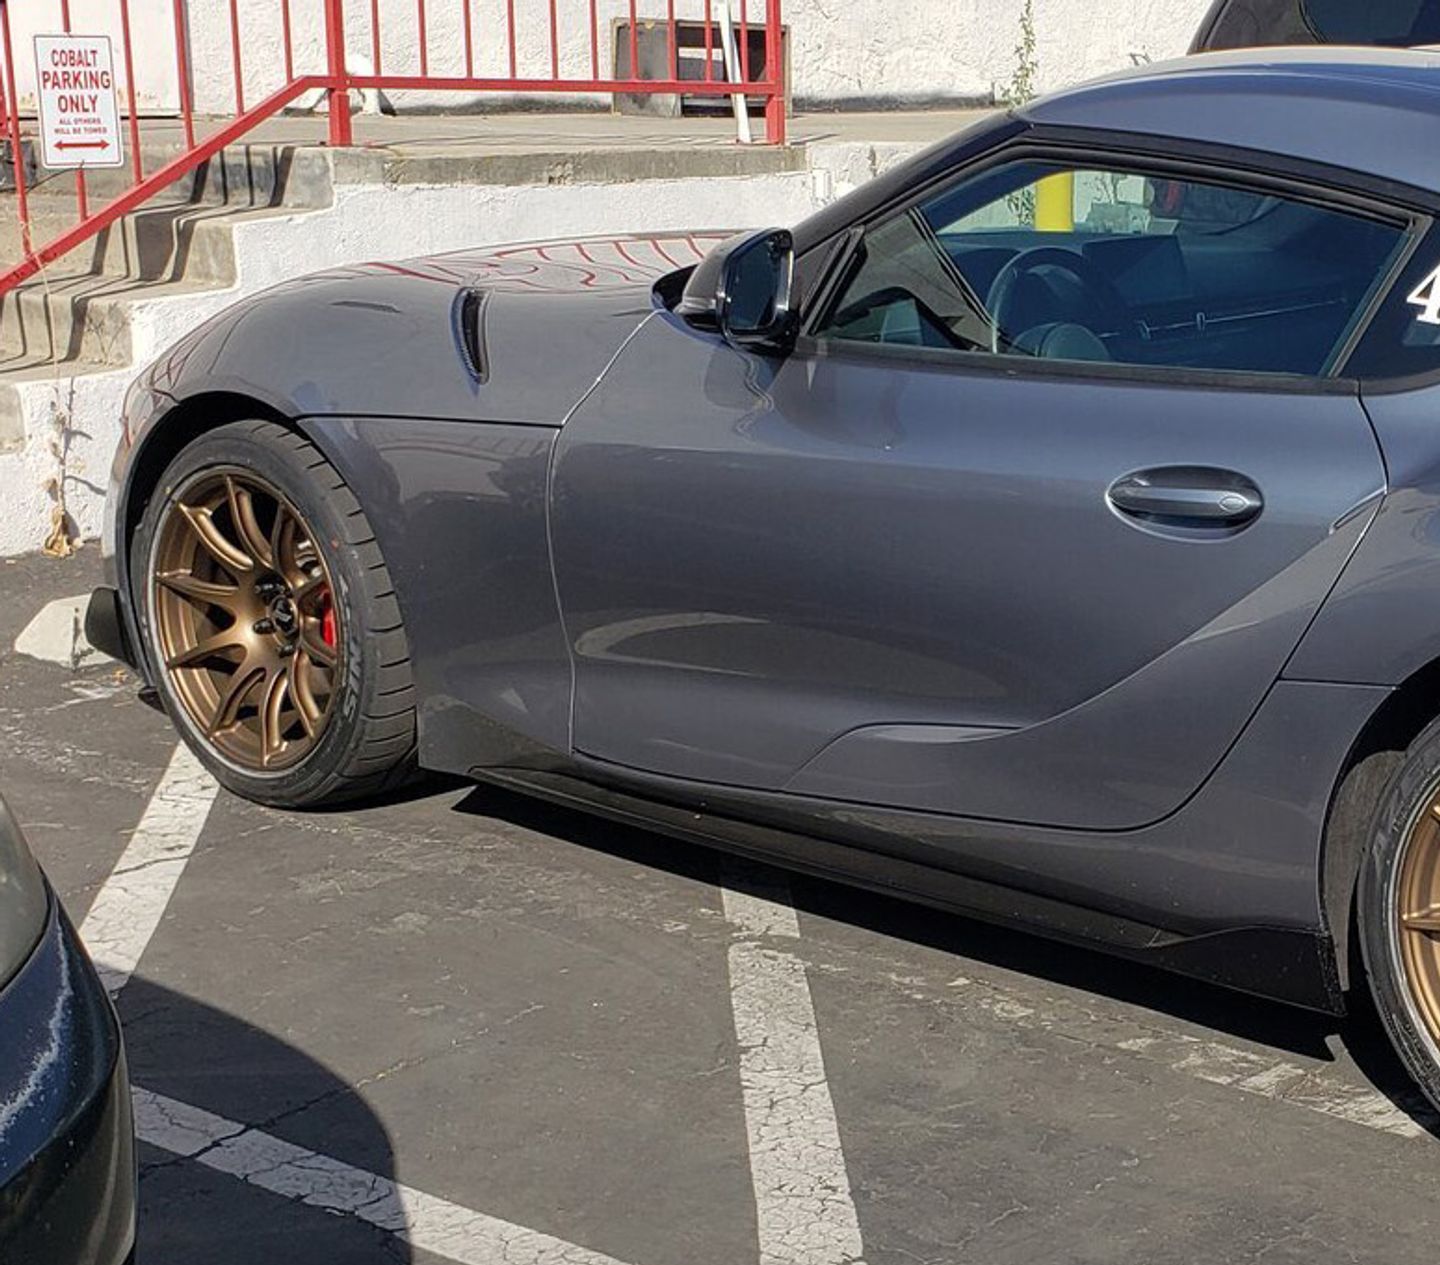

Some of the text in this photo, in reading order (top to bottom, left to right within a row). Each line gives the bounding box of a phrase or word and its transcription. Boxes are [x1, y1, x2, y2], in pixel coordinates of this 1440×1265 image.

[51, 49, 98, 67] COBALT
[42, 71, 111, 89] PARKING
[58, 94, 98, 113] ONLY
[54, 127, 71, 135] WILL
